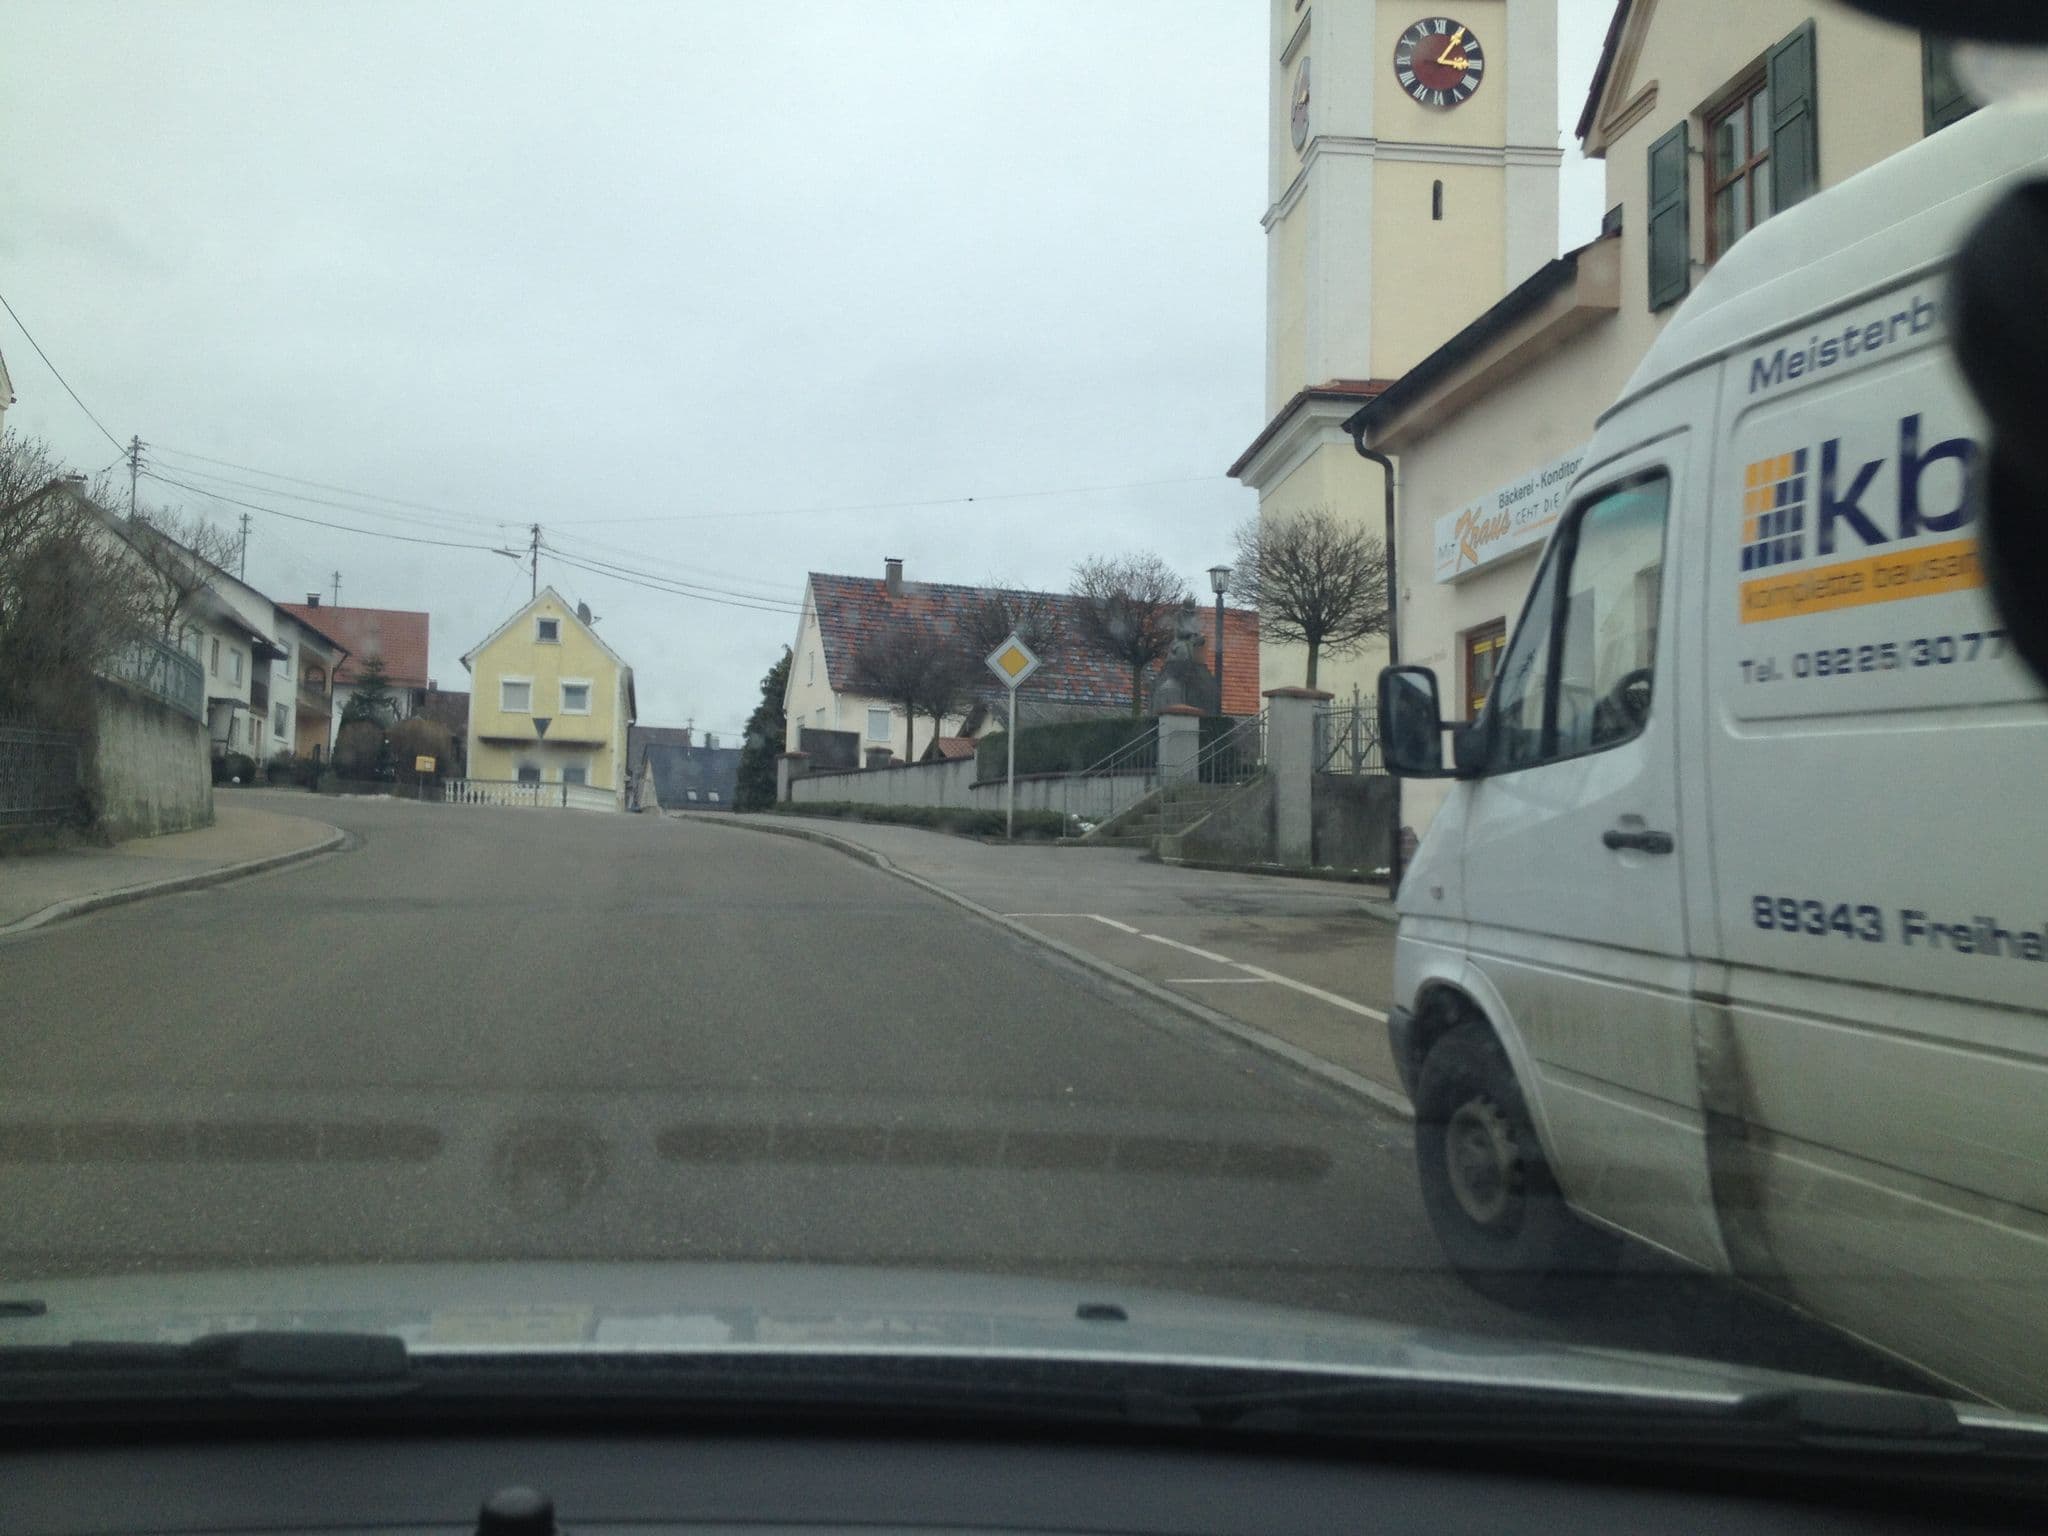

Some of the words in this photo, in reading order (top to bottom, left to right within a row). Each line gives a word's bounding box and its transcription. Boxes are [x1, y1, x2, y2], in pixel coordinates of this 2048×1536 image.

[1748, 296, 1937, 394] Meisterb
[1498, 479, 1534, 509] Bäckerei
[1818, 412, 1981, 556] kb
[1792, 643, 1897, 679] 08225
[1911, 630, 2007, 667] 3077
[1752, 895, 1886, 943] 89343
